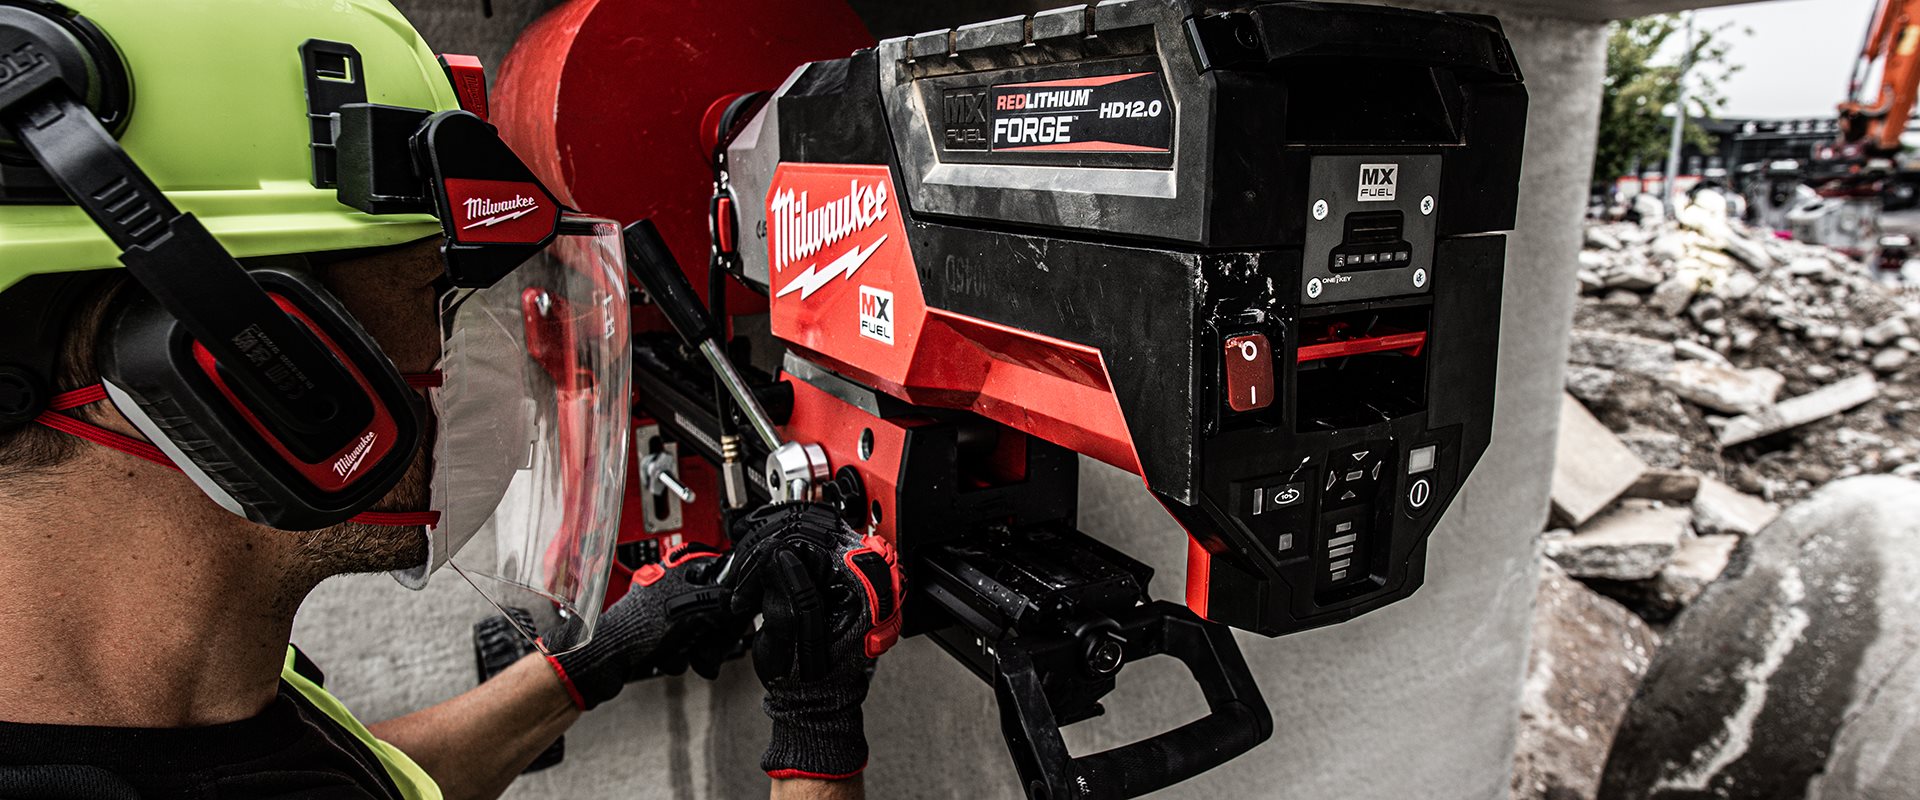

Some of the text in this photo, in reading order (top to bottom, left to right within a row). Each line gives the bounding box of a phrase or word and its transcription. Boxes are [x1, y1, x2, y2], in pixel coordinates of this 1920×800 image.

[944, 92, 987, 125] MX
[1099, 100, 1162, 119] HD12.0
[945, 129, 987, 143] FUEL
[1361, 168, 1395, 186] MX
[1360, 188, 1393, 197] FUEL
[462, 194, 536, 221] Milwaukee
[771, 179, 889, 273] Milwaukee
[861, 292, 890, 323] MX
[861, 319, 891, 339] FUEL
[332, 431, 376, 477] Milwaukee
